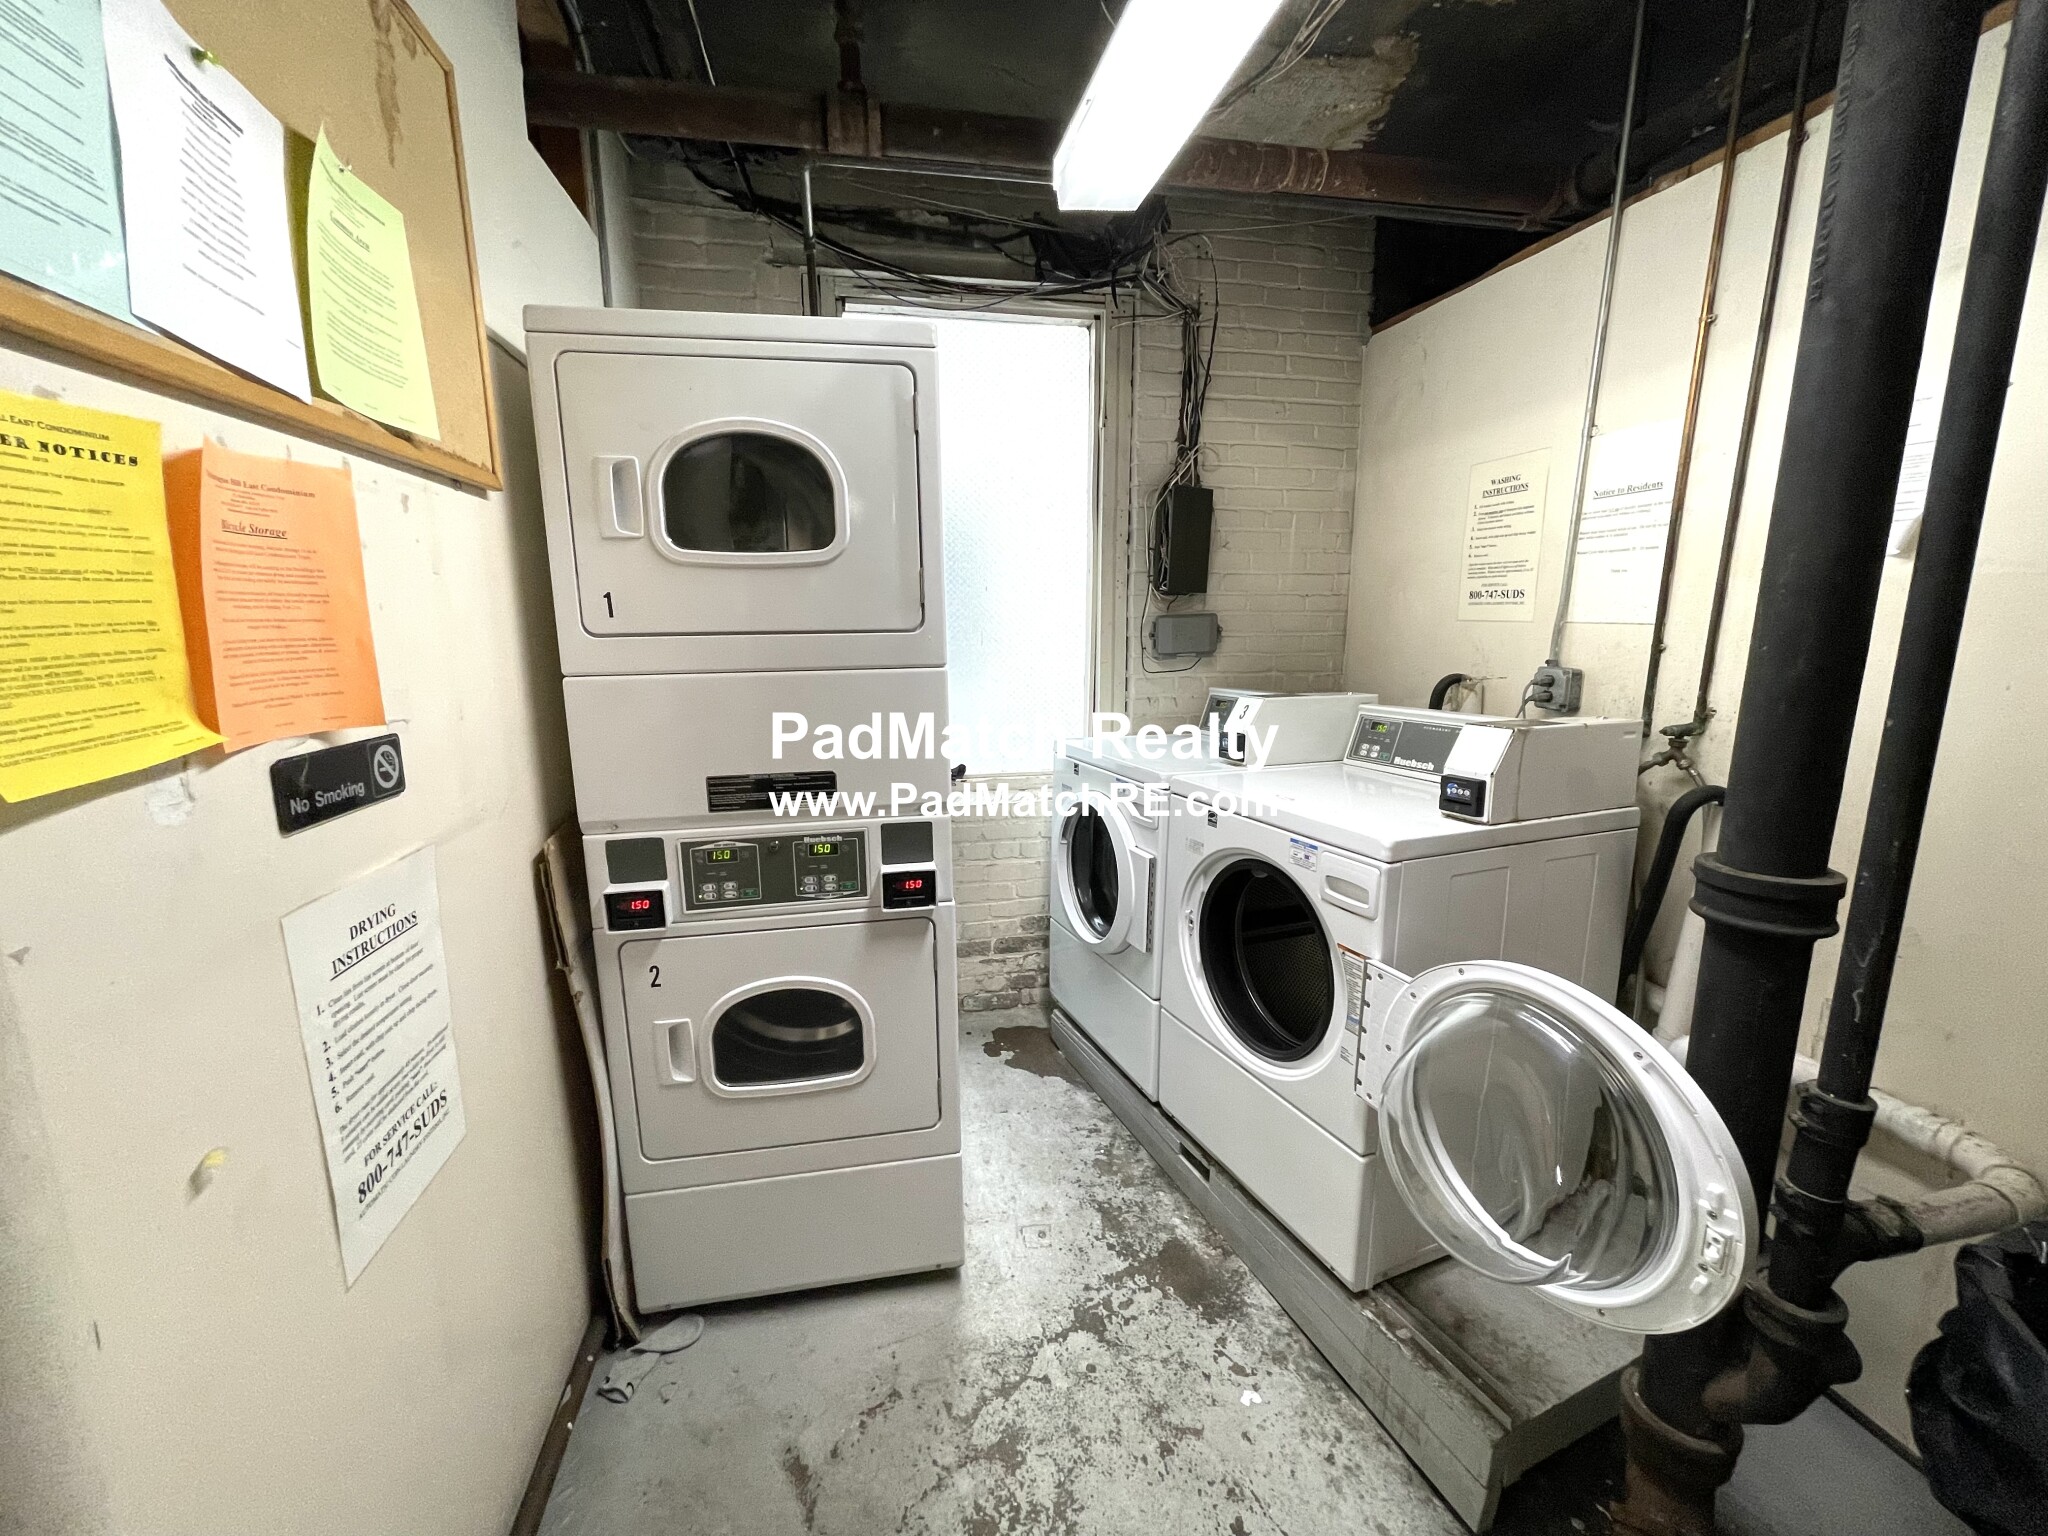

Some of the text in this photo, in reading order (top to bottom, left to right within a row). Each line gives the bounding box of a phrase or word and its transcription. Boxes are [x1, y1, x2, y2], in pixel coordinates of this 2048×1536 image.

[9, 415, 35, 428] EAST
[37, 421, 110, 440] CONDOMINIUM
[37, 440, 138, 467] NOTICES
[1482, 482, 1529, 497] INSTRUCTIONS
[1490, 474, 1521, 486] WASHING
[1594, 489, 1615, 497] Notice
[1626, 481, 1664, 493] Residents
[249, 523, 287, 538] Storage
[603, 591, 614, 618] 1
[1469, 589, 1526, 600] 800-747-SUDS
[1239, 704, 1250, 720] 3
[290, 782, 365, 815] No Smoking
[349, 903, 396, 941] DRYING
[331, 910, 418, 975] INSTRUCTIONS
[649, 965, 662, 988] 2
[358, 1090, 448, 1204] 800-747-SUDS
[364, 1141, 381, 1167] FOR
[383, 1107, 416, 1146] SERVICE
